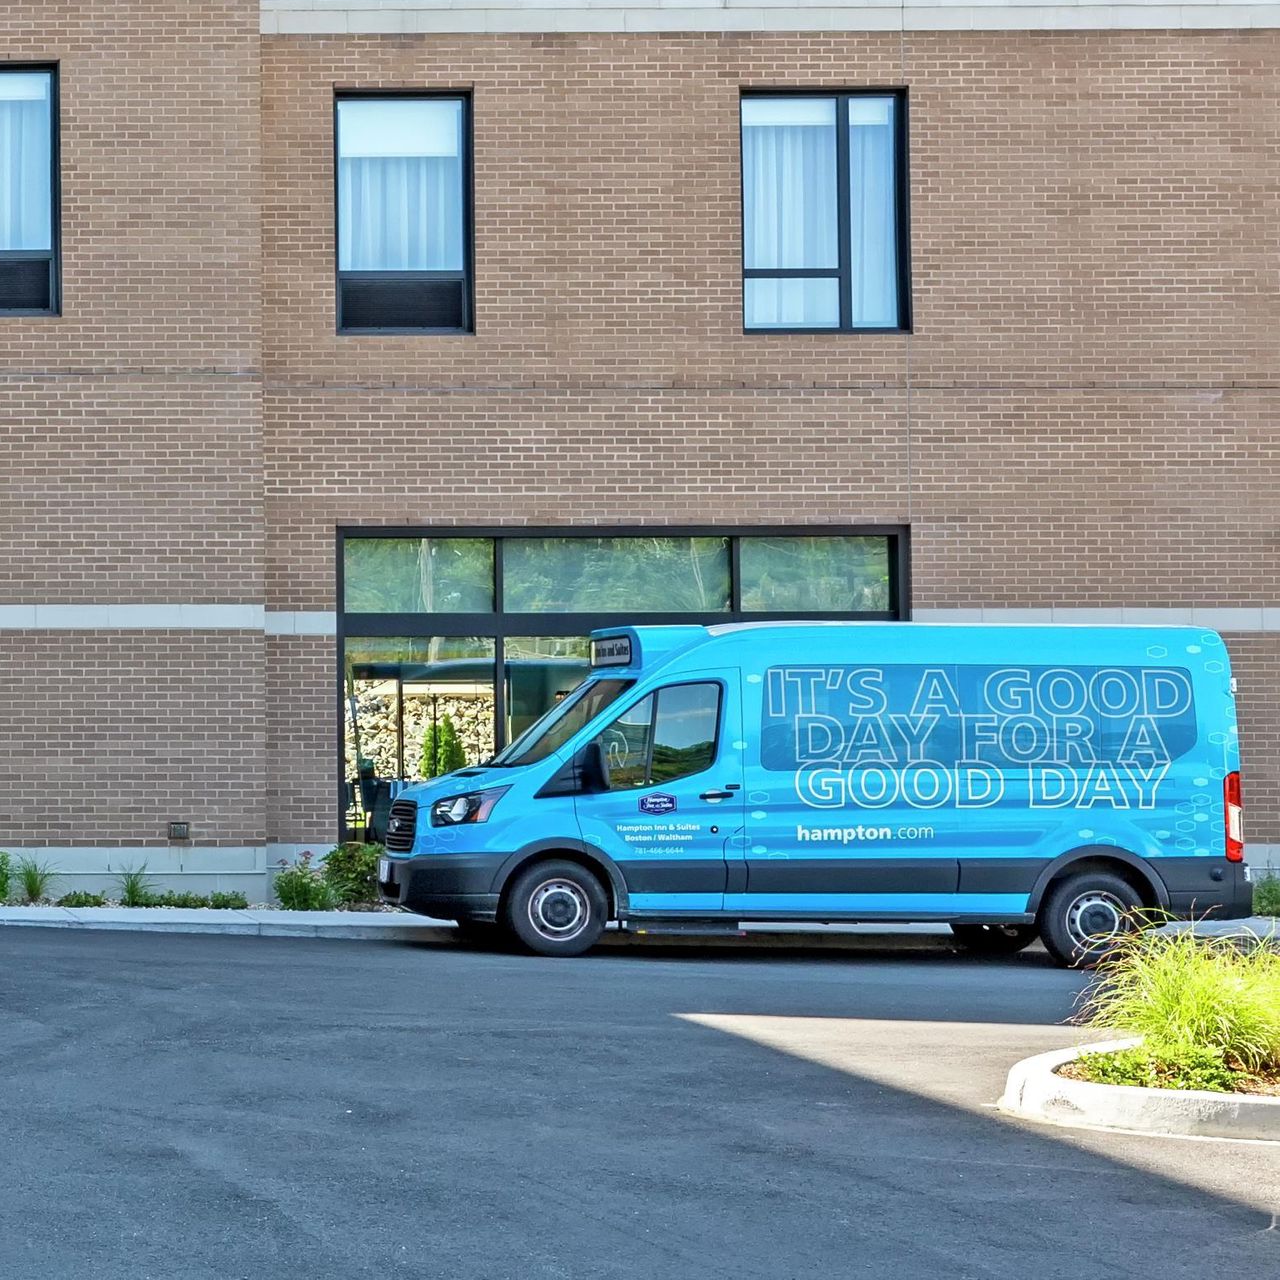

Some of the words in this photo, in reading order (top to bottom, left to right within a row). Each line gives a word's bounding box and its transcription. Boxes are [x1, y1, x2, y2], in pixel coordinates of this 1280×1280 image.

[768, 668, 888, 717] IT'S
[910, 669, 964, 718] A
[983, 669, 1191, 718] GOOD
[795, 714, 940, 762] DAY
[962, 714, 1097, 763] FOR
[1117, 714, 1171, 763] A
[794, 760, 1004, 809] GOOD
[1029, 761, 1171, 809] DAY
[616, 824, 653, 832] Hampton
[657, 833, 693, 841] Waltham
[797, 824, 934, 844] hampton.com
